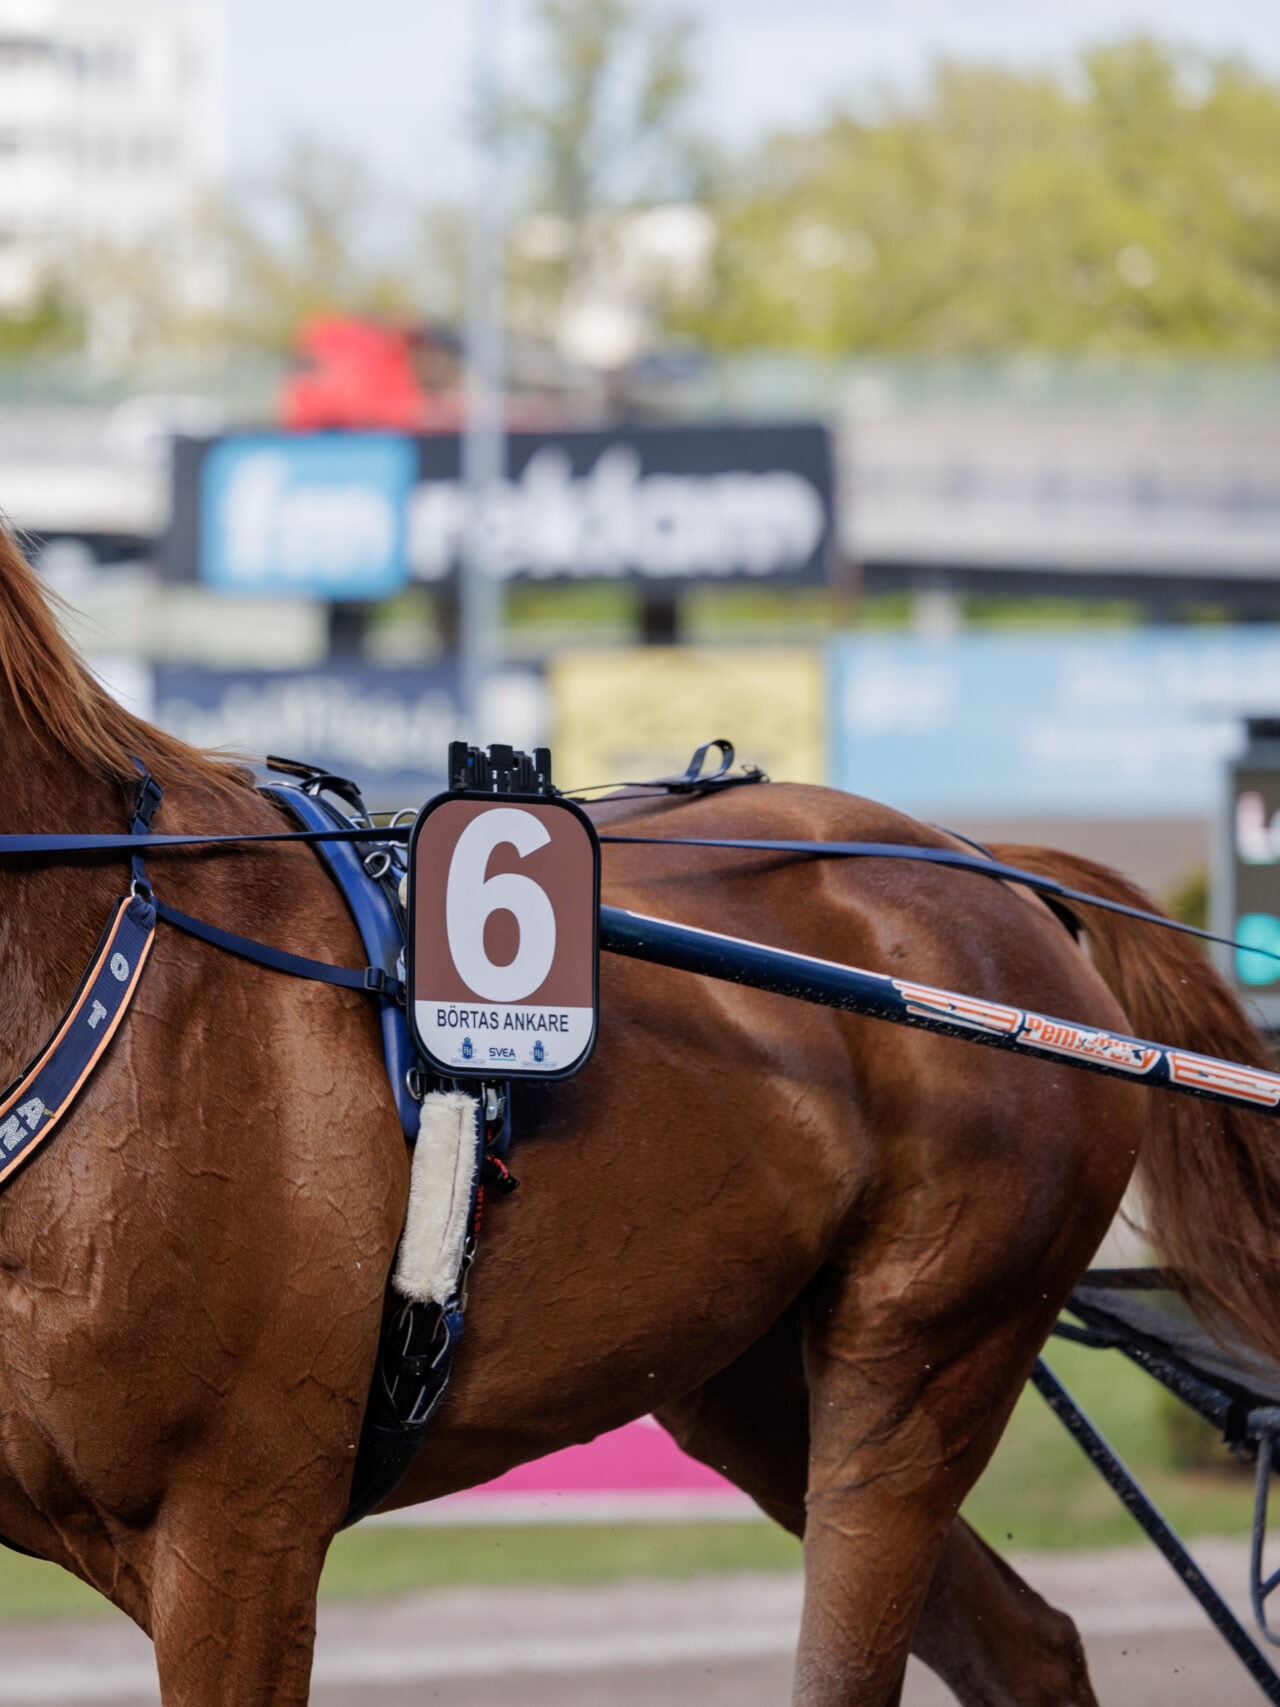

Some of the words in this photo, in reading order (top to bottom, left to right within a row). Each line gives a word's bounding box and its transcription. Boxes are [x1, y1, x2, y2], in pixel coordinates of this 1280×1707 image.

[222, 449, 400, 578] fm
[446, 807, 557, 1003] 6
[437, 1005, 499, 1030] BÖRTAS
[503, 1011, 569, 1033] ANKARE
[489, 1047, 516, 1058] SVEA
